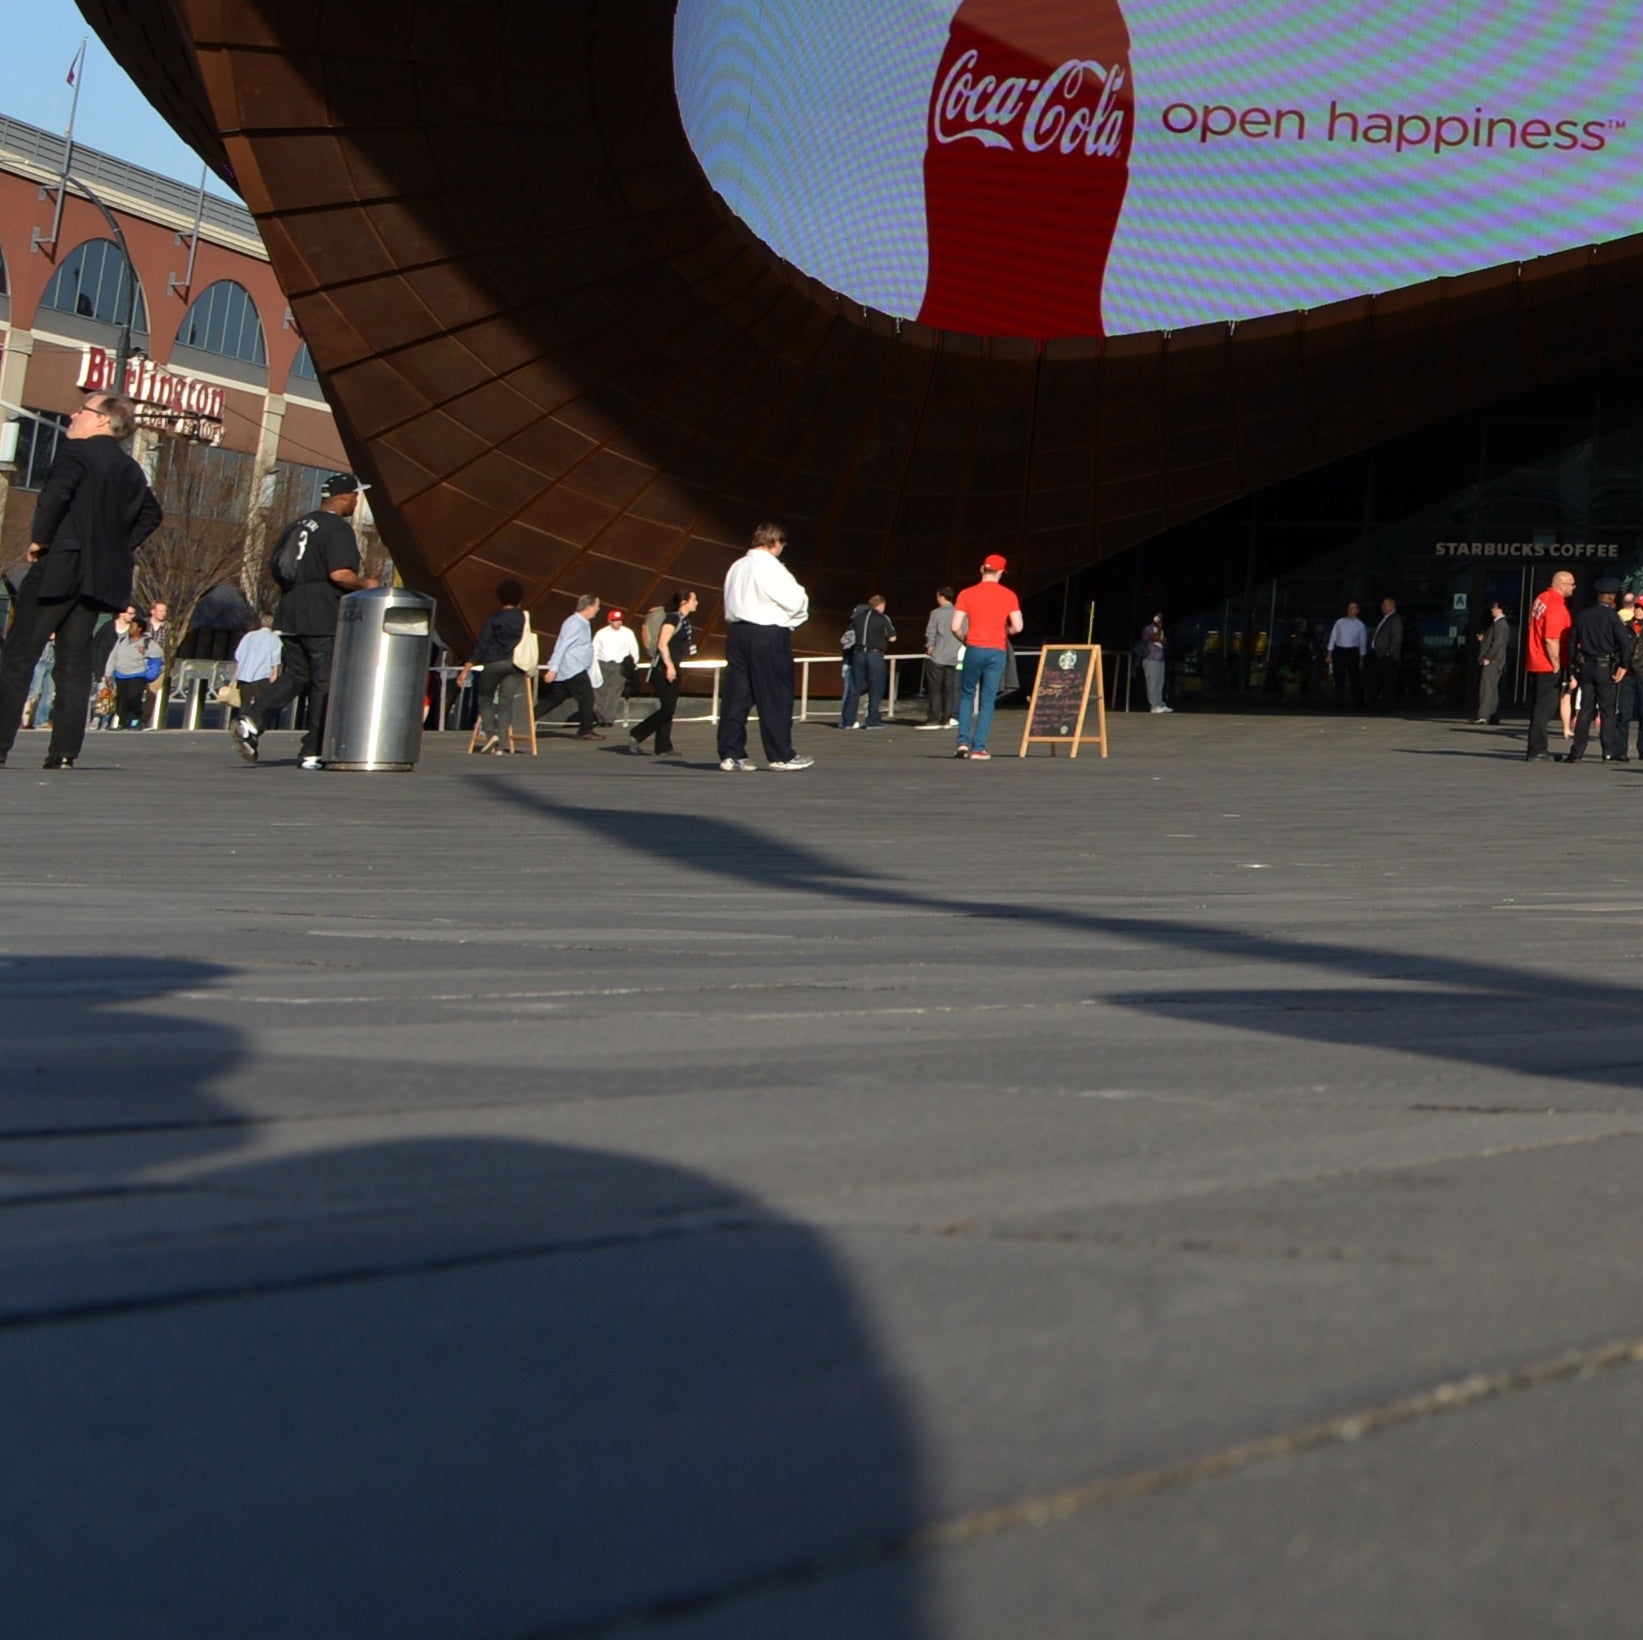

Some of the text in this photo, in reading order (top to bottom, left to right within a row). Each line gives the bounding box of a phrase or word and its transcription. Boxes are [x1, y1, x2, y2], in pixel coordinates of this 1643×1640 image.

[933, 48, 1124, 158] Coca-Cola
[1162, 101, 1305, 143] open
[1435, 541, 1619, 558] STARBUCKS COFFEE
